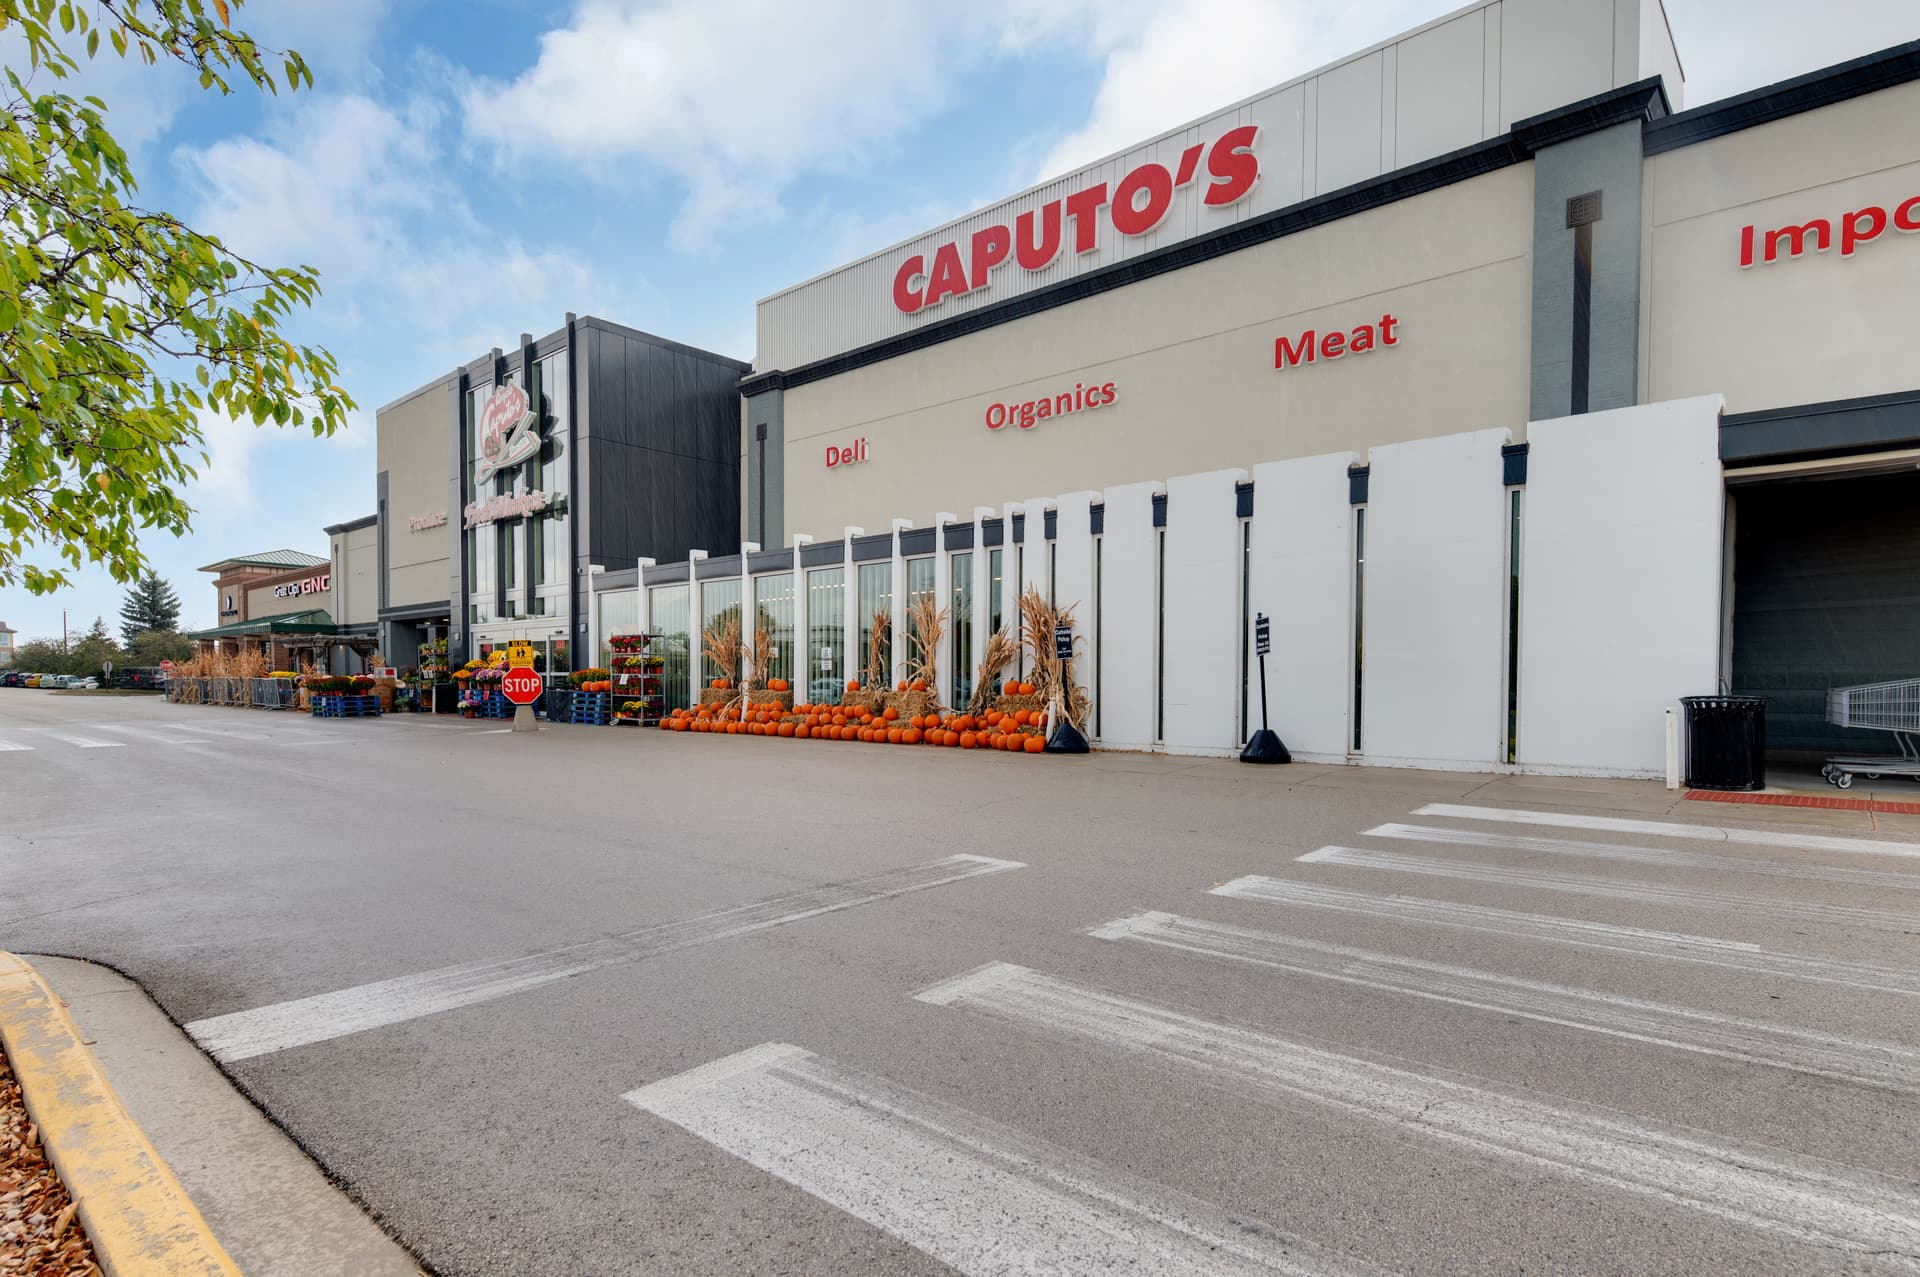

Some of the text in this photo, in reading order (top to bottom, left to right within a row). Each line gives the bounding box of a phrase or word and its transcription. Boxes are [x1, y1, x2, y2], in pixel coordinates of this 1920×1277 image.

[893, 126, 1259, 313] CAPUTO'S
[1274, 313, 1398, 369] Meat
[985, 382, 1116, 430] Organics
[825, 436, 866, 468] Deli
[408, 513, 446, 531] Produce
[301, 575, 331, 594] GNC
[505, 678, 539, 692] STOP
